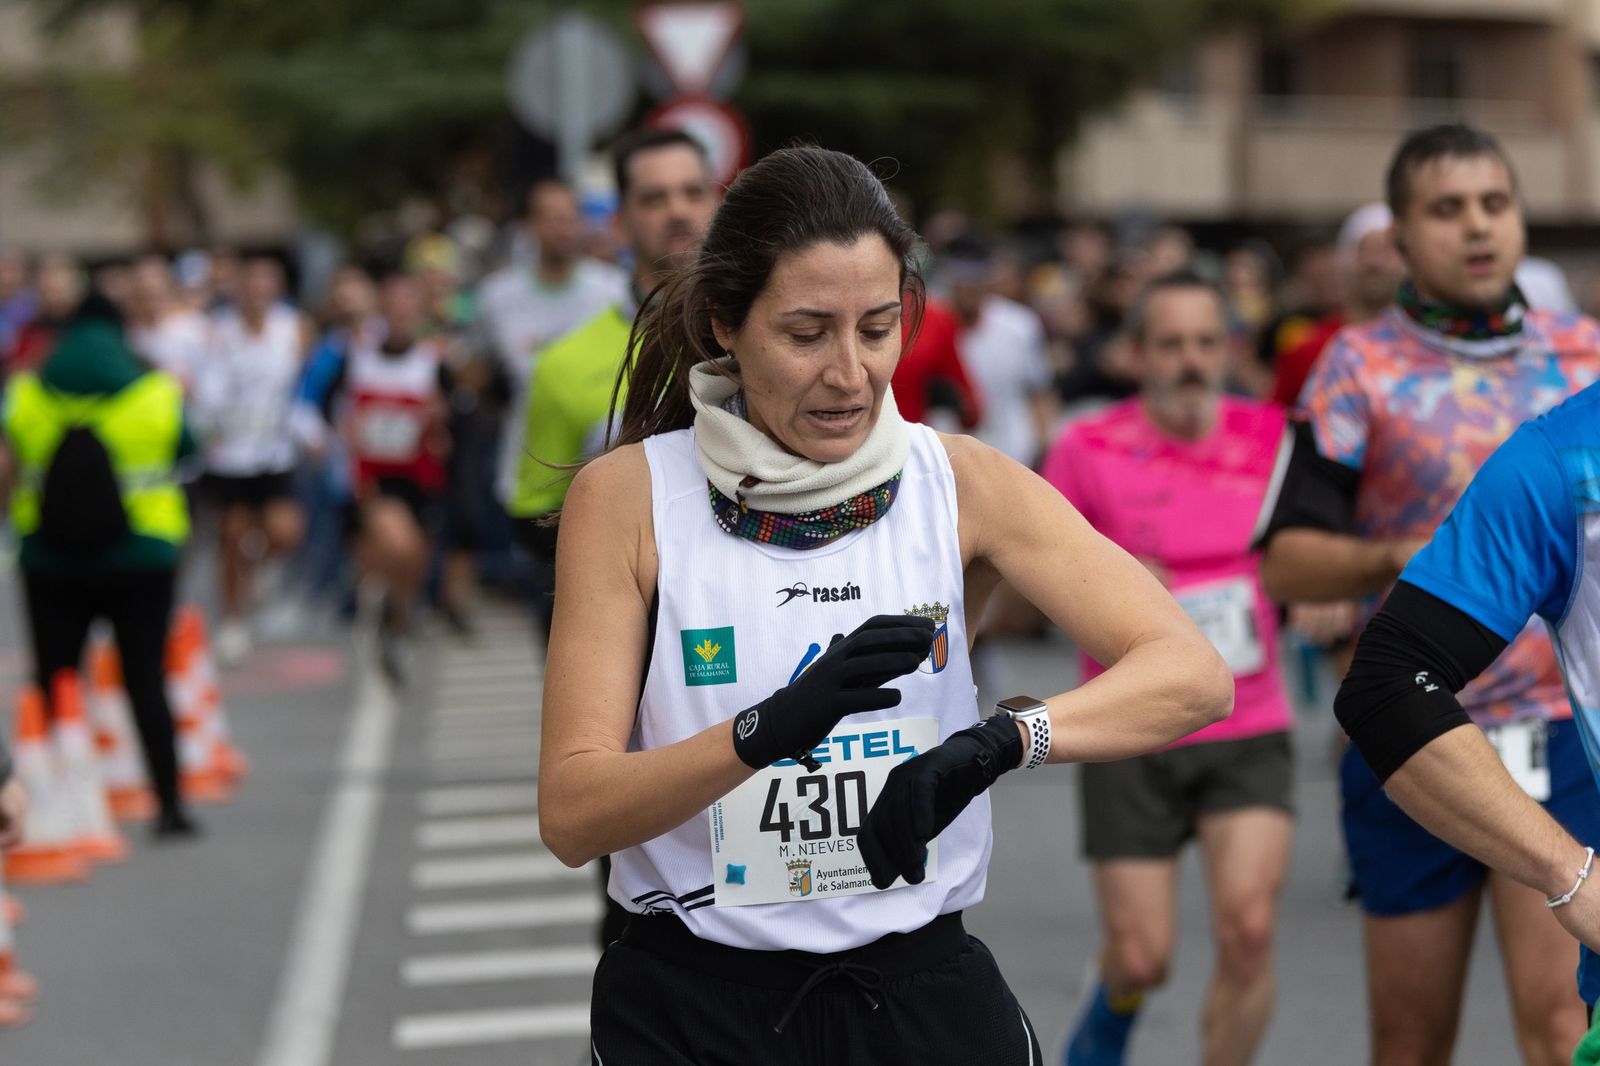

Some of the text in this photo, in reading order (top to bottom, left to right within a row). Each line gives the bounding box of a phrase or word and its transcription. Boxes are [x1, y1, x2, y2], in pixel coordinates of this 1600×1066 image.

[812, 581, 861, 603] rasán
[707, 662, 730, 670] RURAL
[770, 729, 916, 768] ETEL
[759, 770, 868, 843] 430
[816, 865, 869, 880] Ayuntamien
[817, 878, 873, 893] de Salamanc
